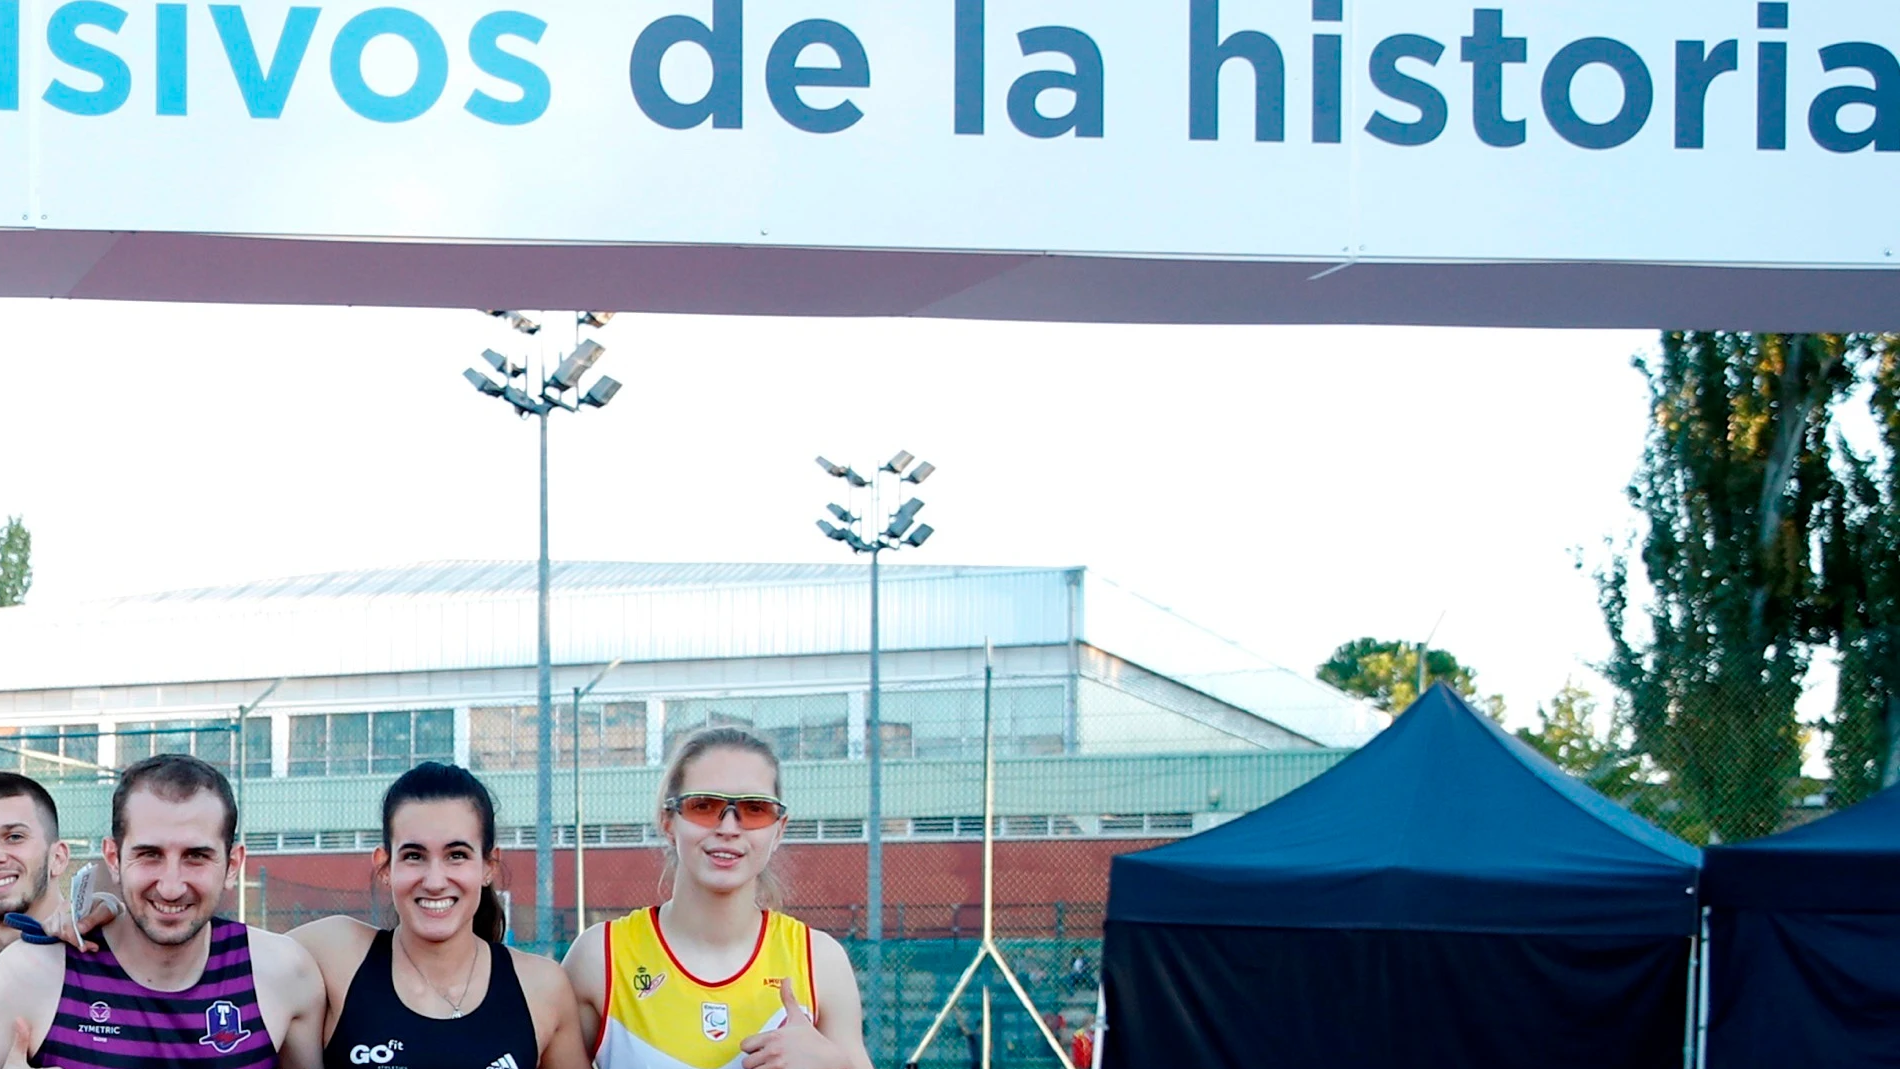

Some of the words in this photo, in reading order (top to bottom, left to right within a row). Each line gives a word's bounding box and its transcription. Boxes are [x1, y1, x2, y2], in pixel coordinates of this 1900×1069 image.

[630, 0, 870, 133] de
[955, 0, 1104, 138] la
[1190, 0, 1900, 153] historia
[78, 1024, 121, 1035] ZYMETRIC
[388, 1039, 404, 1051] fit
